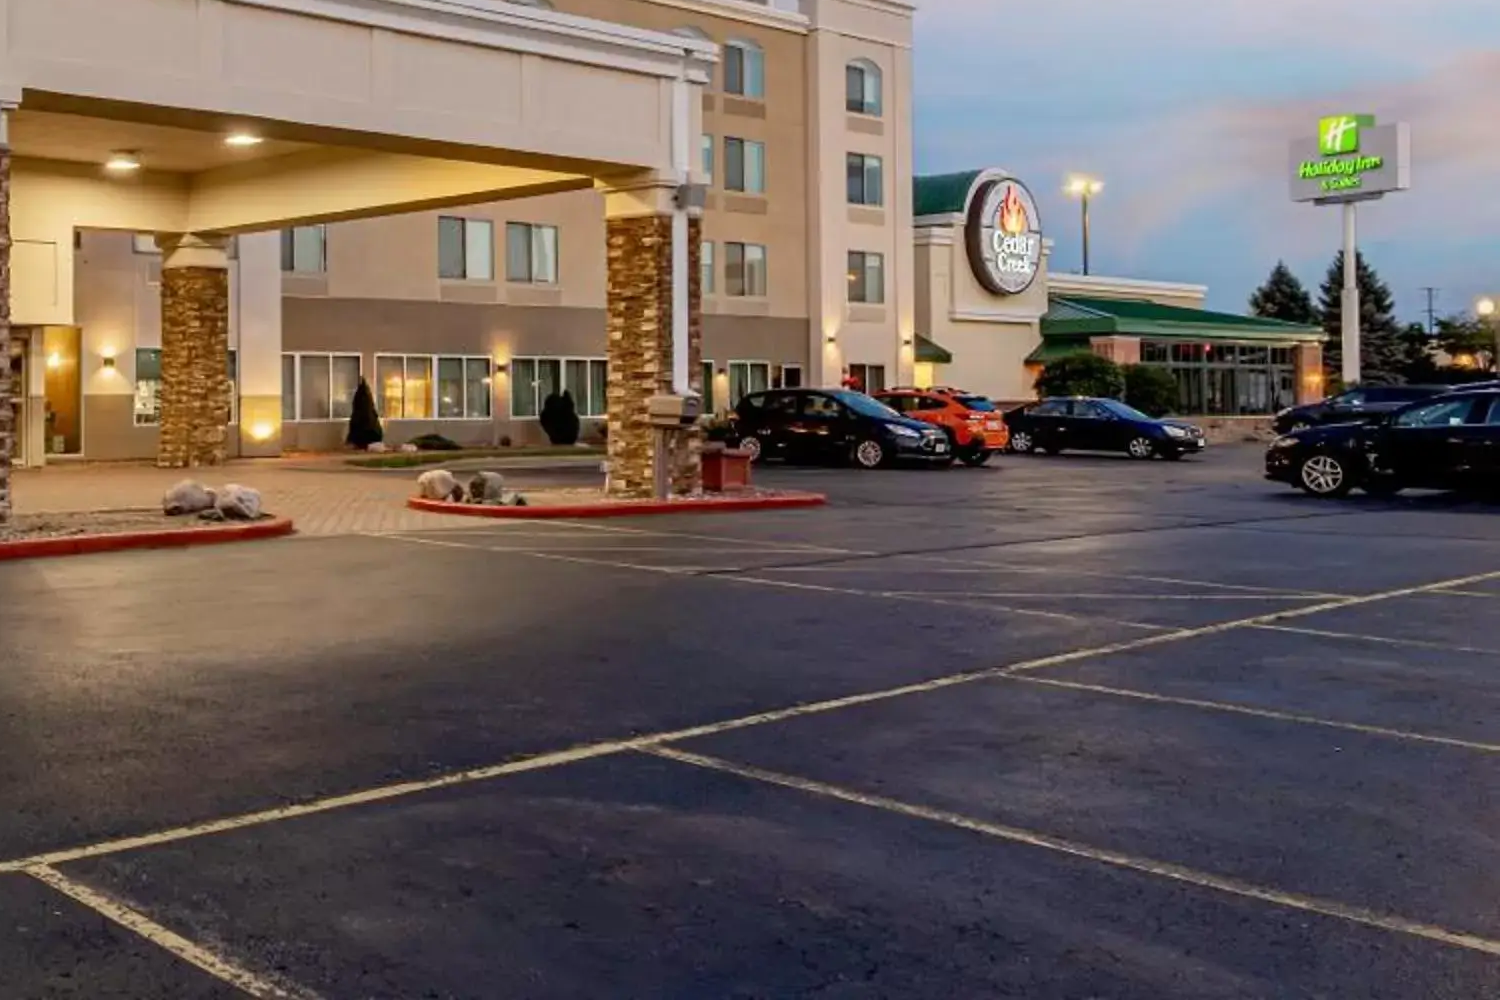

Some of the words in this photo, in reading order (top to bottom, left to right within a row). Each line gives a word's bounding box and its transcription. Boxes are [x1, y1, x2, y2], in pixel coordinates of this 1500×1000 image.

[1299, 158, 1356, 179] Holiday
[1356, 156, 1383, 171] Inn
[993, 230, 1034, 255] Cedar
[998, 253, 1032, 272] Creek
